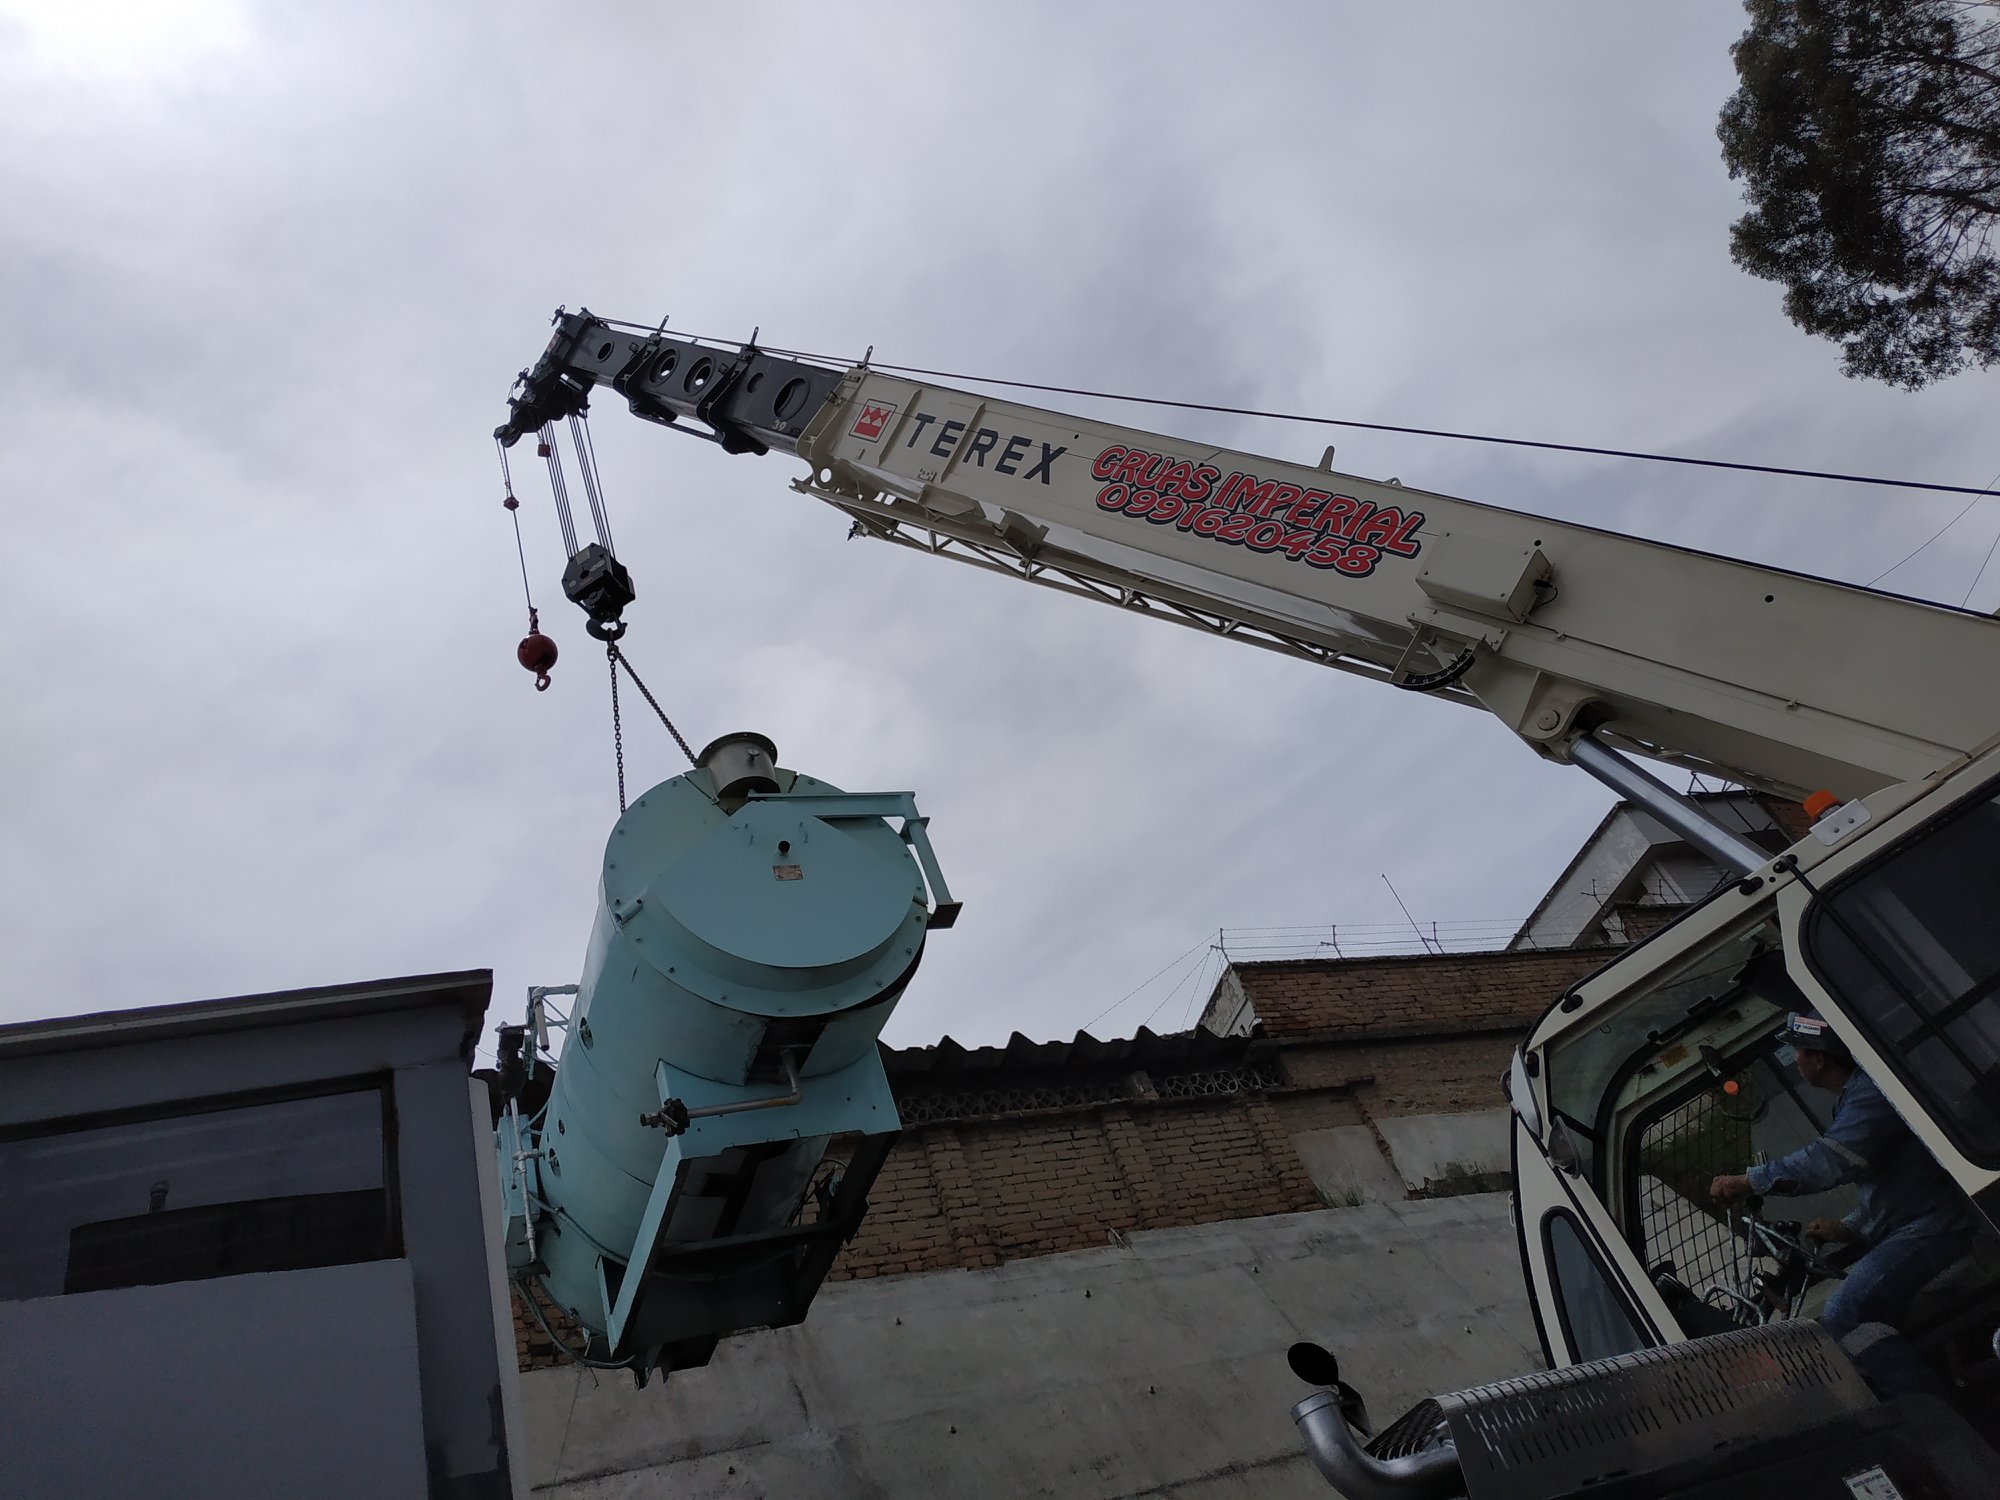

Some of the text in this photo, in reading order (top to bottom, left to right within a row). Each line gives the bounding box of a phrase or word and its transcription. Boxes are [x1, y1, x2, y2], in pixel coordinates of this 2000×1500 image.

[907, 413, 1068, 485] TEREX
[1091, 445, 1426, 559] GRUAS IMPERIAL
[1096, 482, 1383, 578] 0991620458
